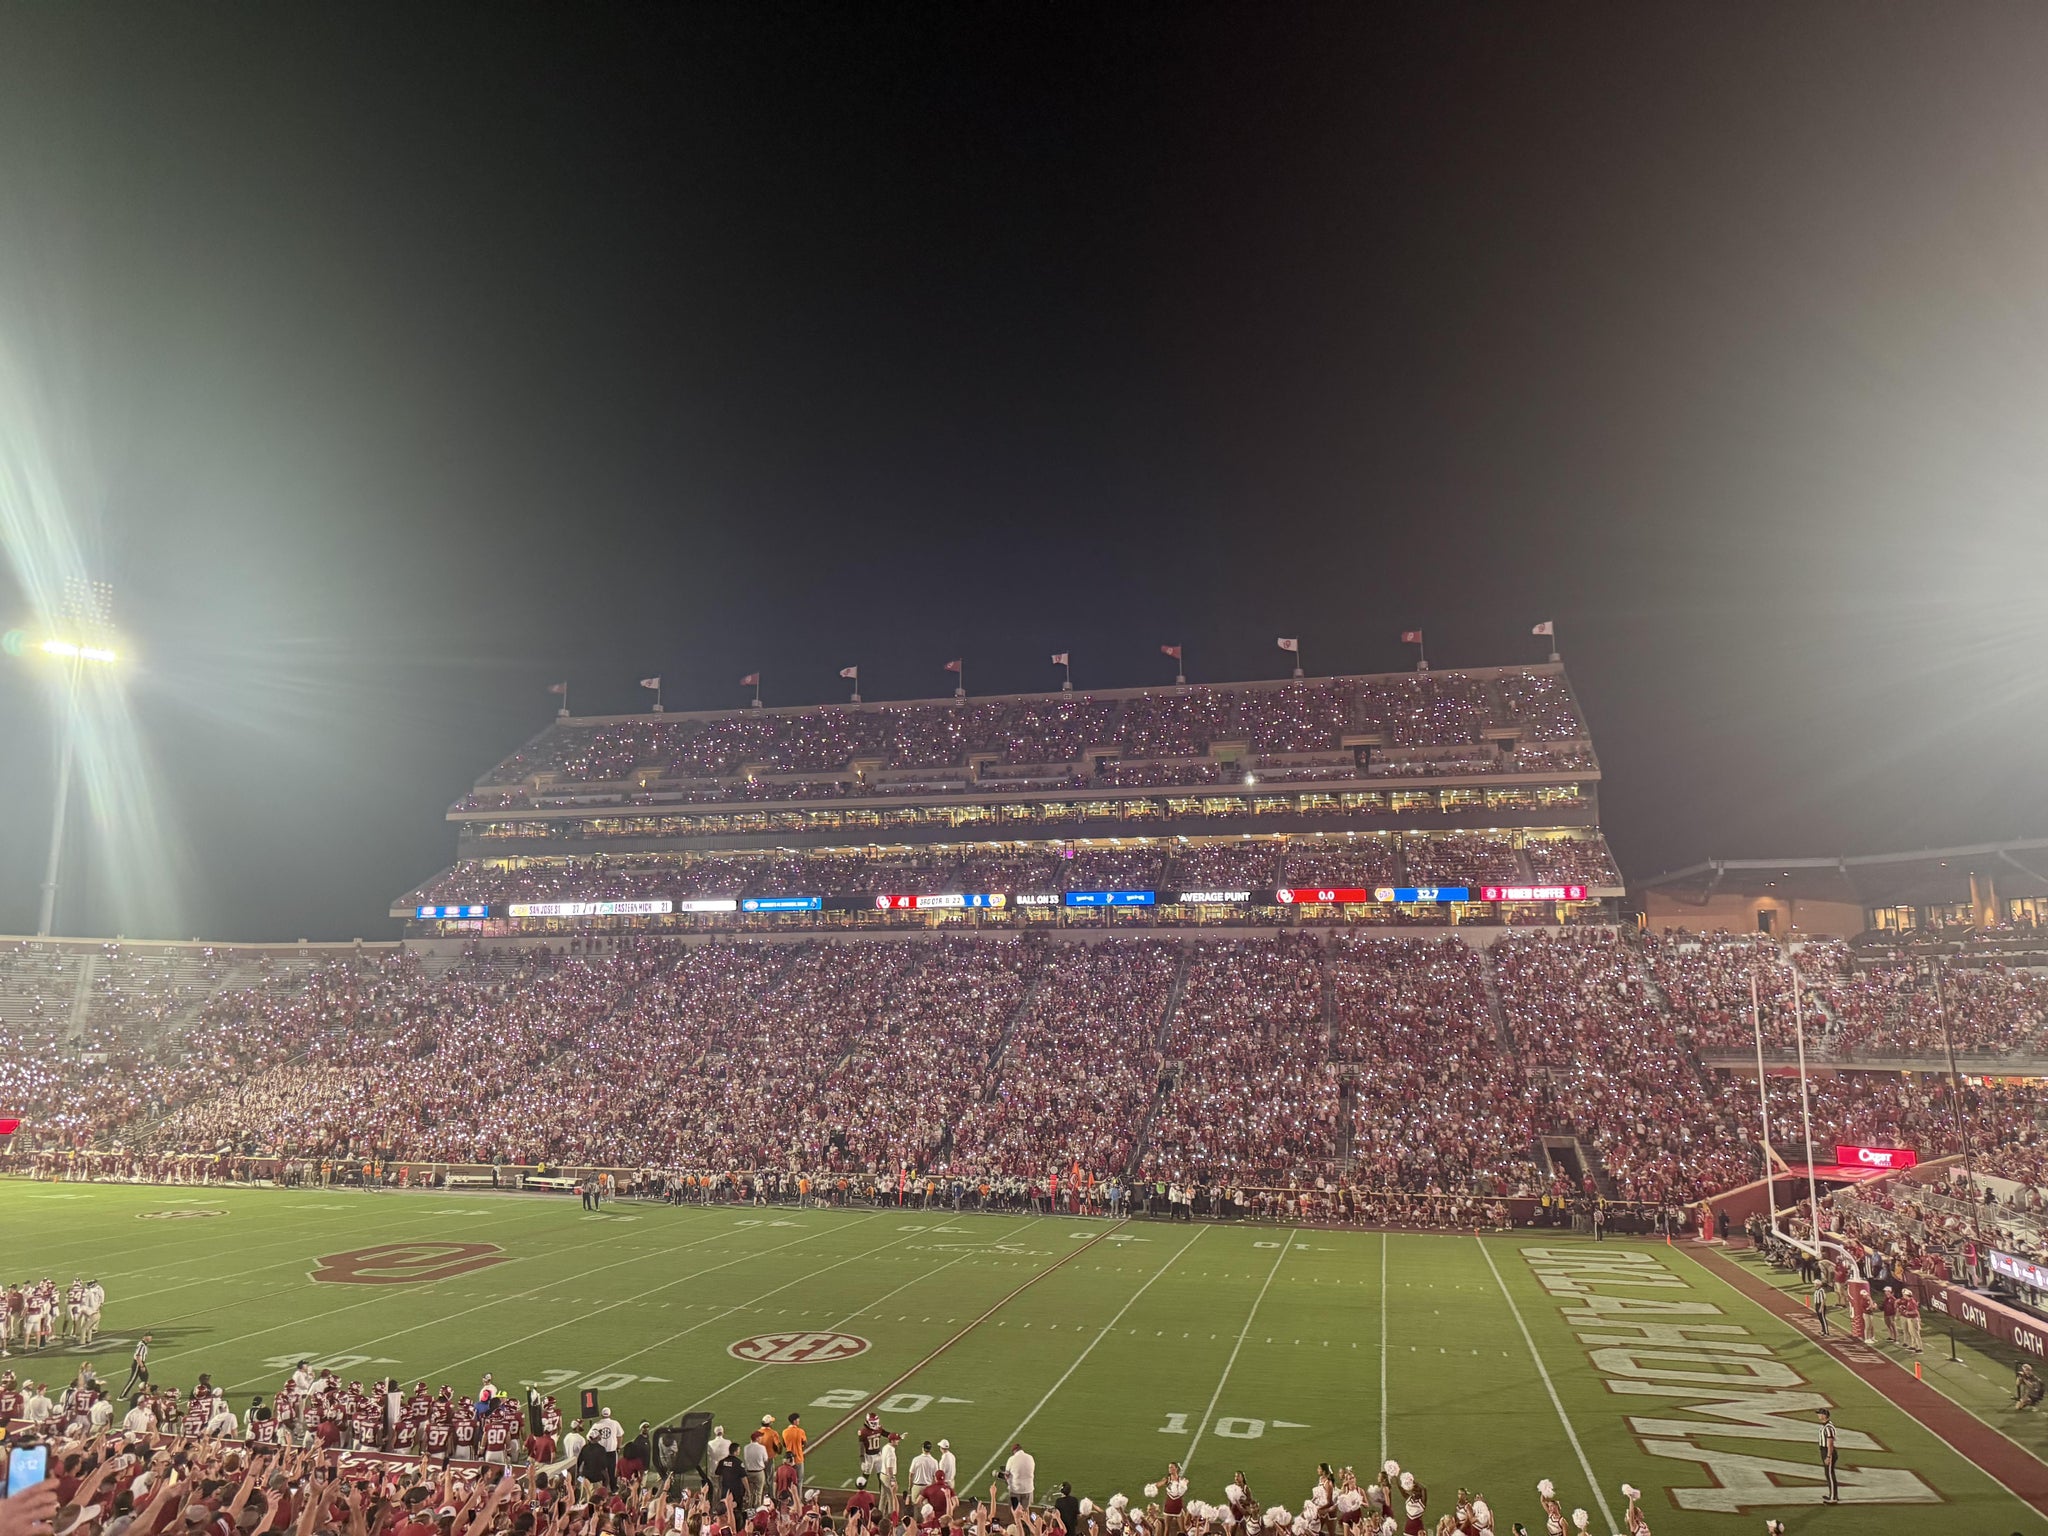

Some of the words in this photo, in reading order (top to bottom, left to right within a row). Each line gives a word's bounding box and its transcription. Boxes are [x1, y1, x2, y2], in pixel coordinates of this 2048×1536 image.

[1016, 895, 1036, 905] BALL
[1180, 892, 1224, 902] AVERAGE
[1224, 892, 1250, 902] PUNT
[614, 905, 637, 914] EASTERN
[1962, 1302, 1987, 1329] OATH
[736, 1332, 861, 1362] SEC
[2014, 1326, 2044, 1356] OATH
[262, 1352, 372, 1371] 40
[519, 1369, 639, 1390] 30
[1519, 1247, 1946, 1514] OKLAHOMA
[1, 1398, 16, 1412] 17
[77, 1397, 90, 1411] 31
[586, 1392, 593, 1408] 1
[808, 1389, 936, 1413] 20
[412, 1401, 428, 1416] 55
[184, 1422, 203, 1434] 27
[259, 1426, 274, 1441] 19
[456, 1427, 474, 1441] 40
[1157, 1413, 1266, 1440] 10
[398, 1428, 417, 1442] 44
[428, 1430, 449, 1446] 97
[488, 1429, 506, 1445] 80
[868, 1438, 880, 1450] 10
